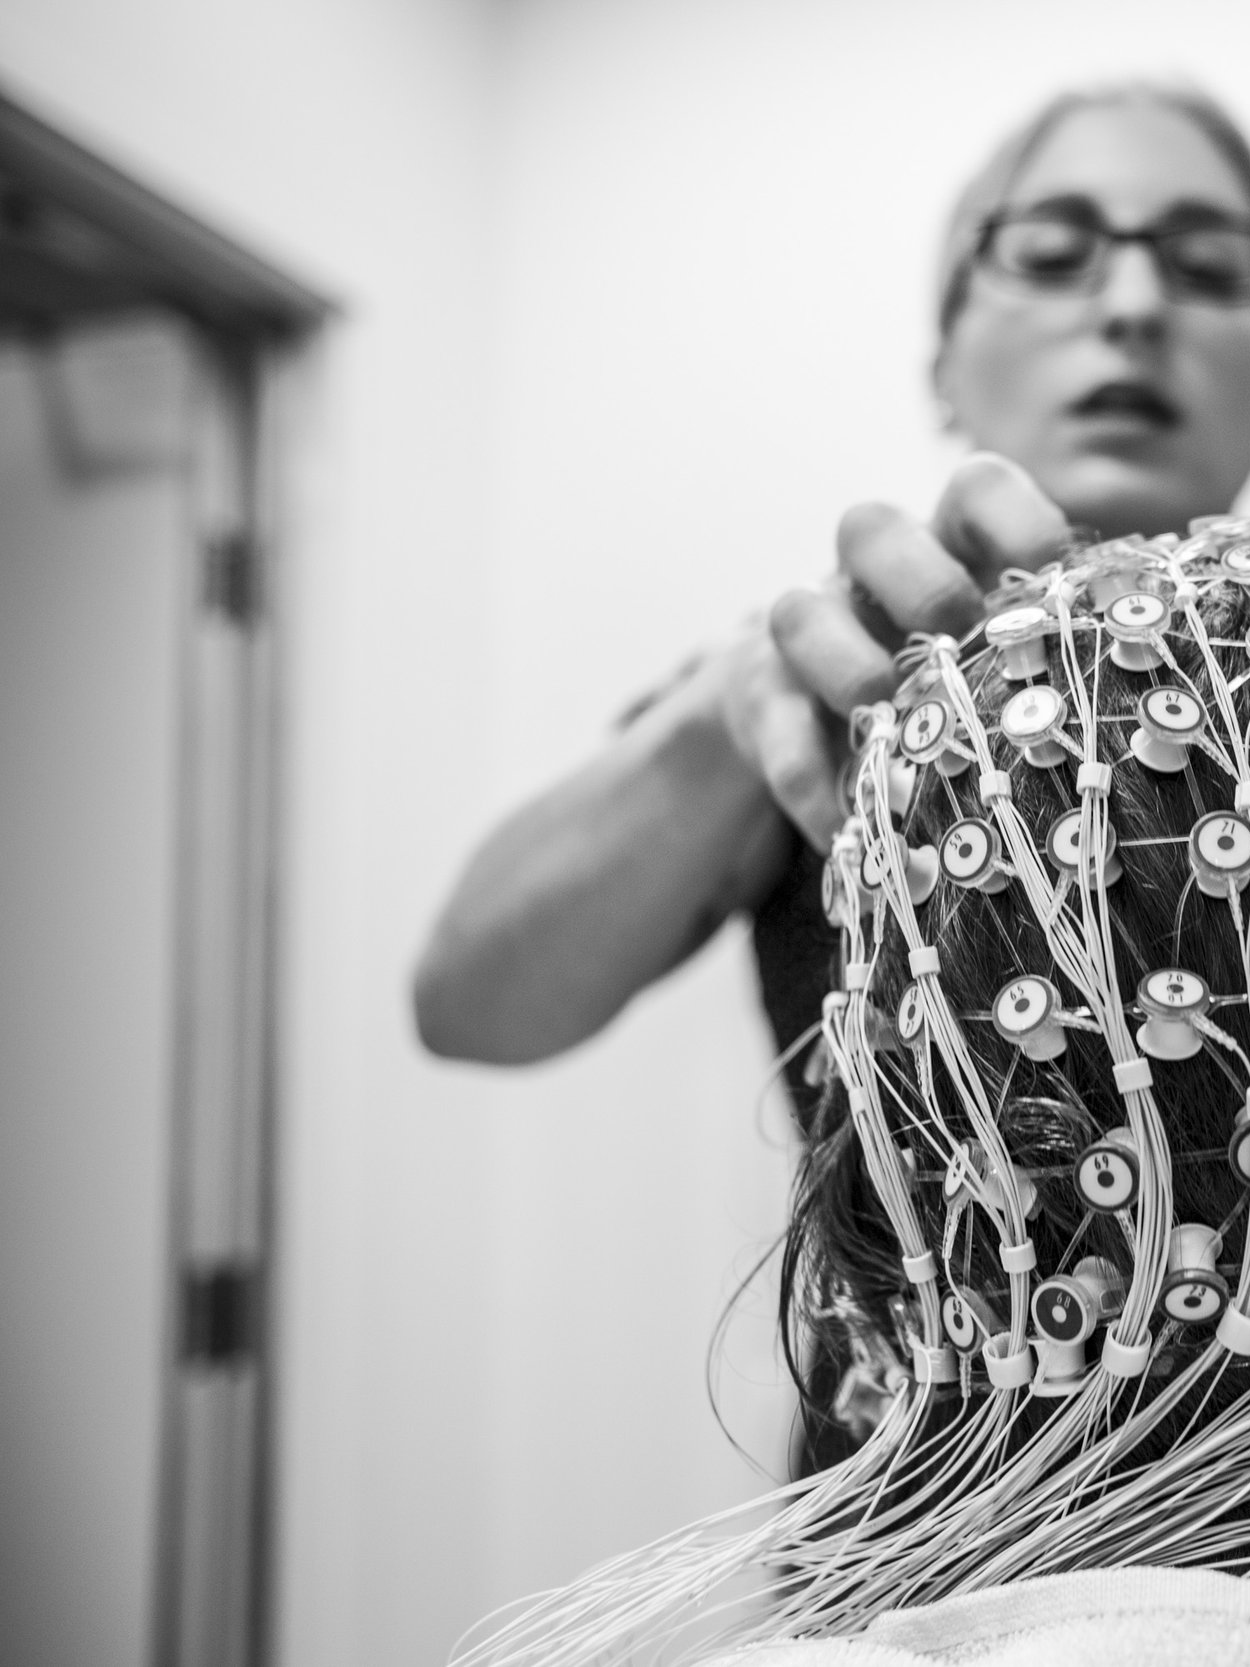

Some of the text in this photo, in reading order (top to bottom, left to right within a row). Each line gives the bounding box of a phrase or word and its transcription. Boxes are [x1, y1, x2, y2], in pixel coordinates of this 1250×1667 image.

[1129, 596, 1140, 606] 61
[1166, 692, 1180, 703] 67
[1222, 820, 1235, 834] 71
[949, 833, 962, 850] 59
[1168, 973, 1183, 983] 70
[1010, 984, 1024, 1001] 65
[1094, 1154, 1109, 1170] 69
[953, 1299, 962, 1314] 63
[1056, 1292, 1071, 1309] 68
